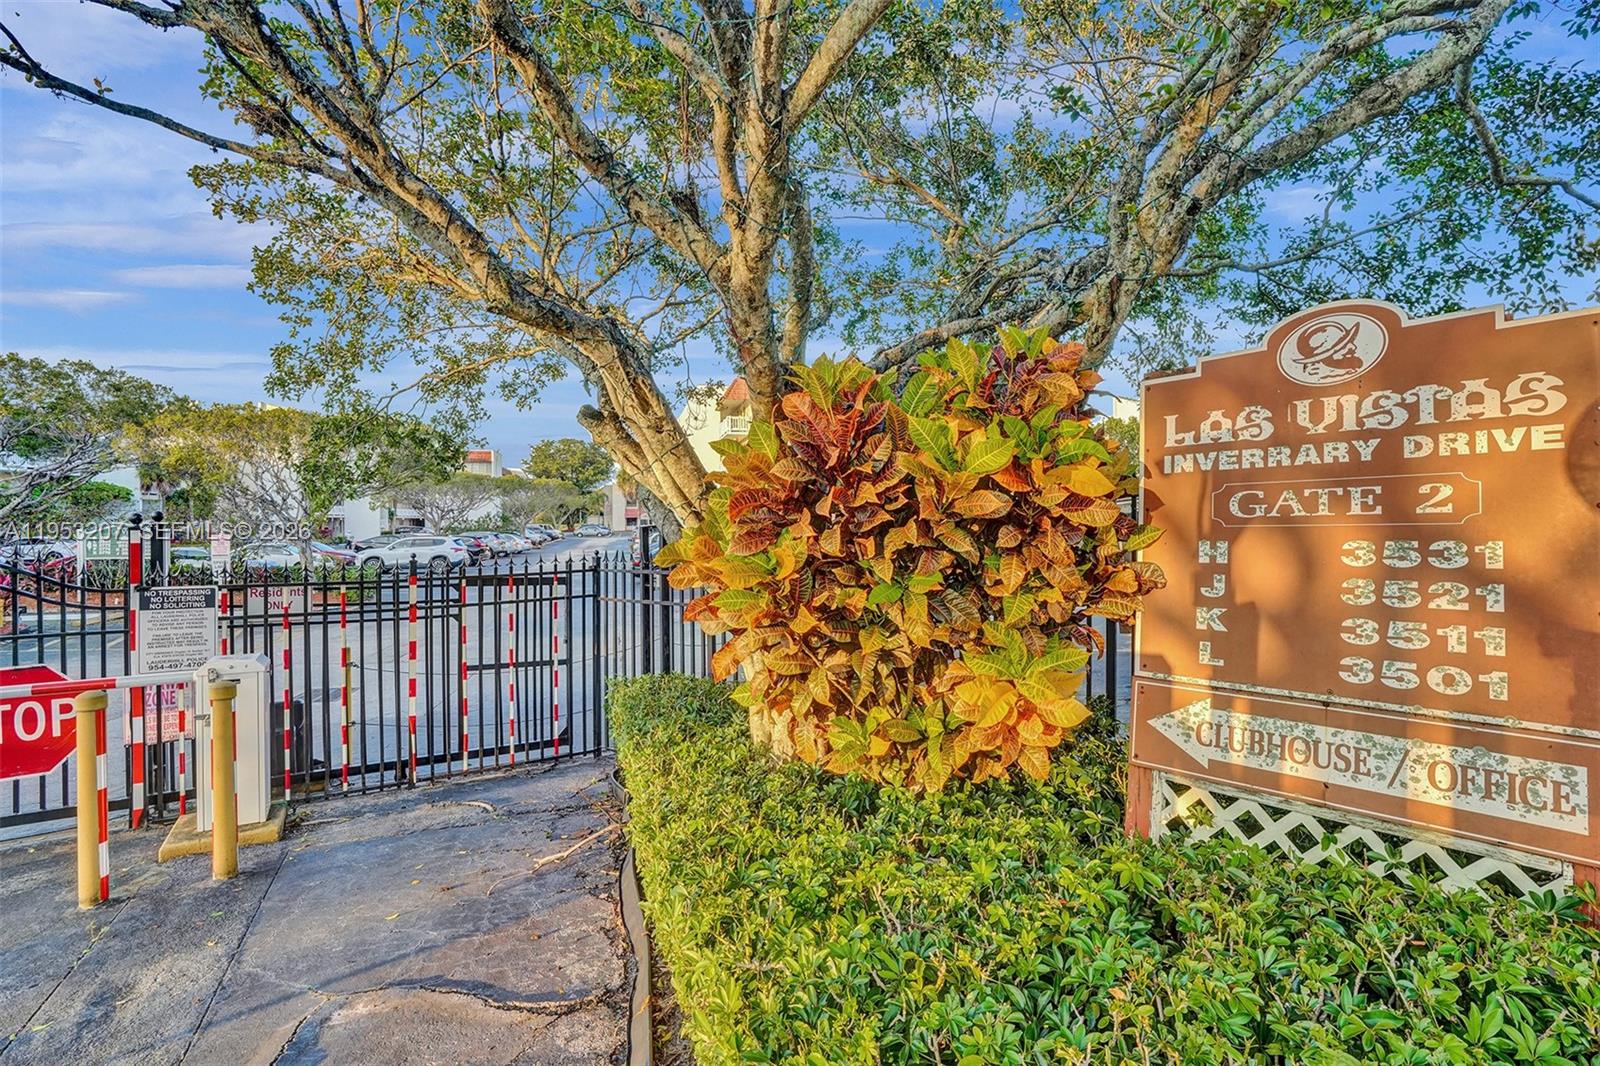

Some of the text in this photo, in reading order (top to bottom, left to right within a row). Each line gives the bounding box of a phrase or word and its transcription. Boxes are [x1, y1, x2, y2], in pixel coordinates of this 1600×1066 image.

[1164, 371, 1568, 448] LAS VISTAS
[1164, 424, 1565, 474] INVERRARY DRIVE
[1229, 483, 1454, 518] GATE 2
[1198, 540, 1504, 569] H 3531
[158, 589, 211, 597] TRESPASSING
[163, 601, 206, 609] SOLICITING
[250, 587, 306, 598] Residnts
[1200, 574, 1505, 612] J 3521
[1196, 607, 1506, 656] K 3511
[1199, 641, 1508, 701] L 3501
[1195, 721, 1372, 777] CLUBHOUSE
[1427, 760, 1576, 817] OFFICE
